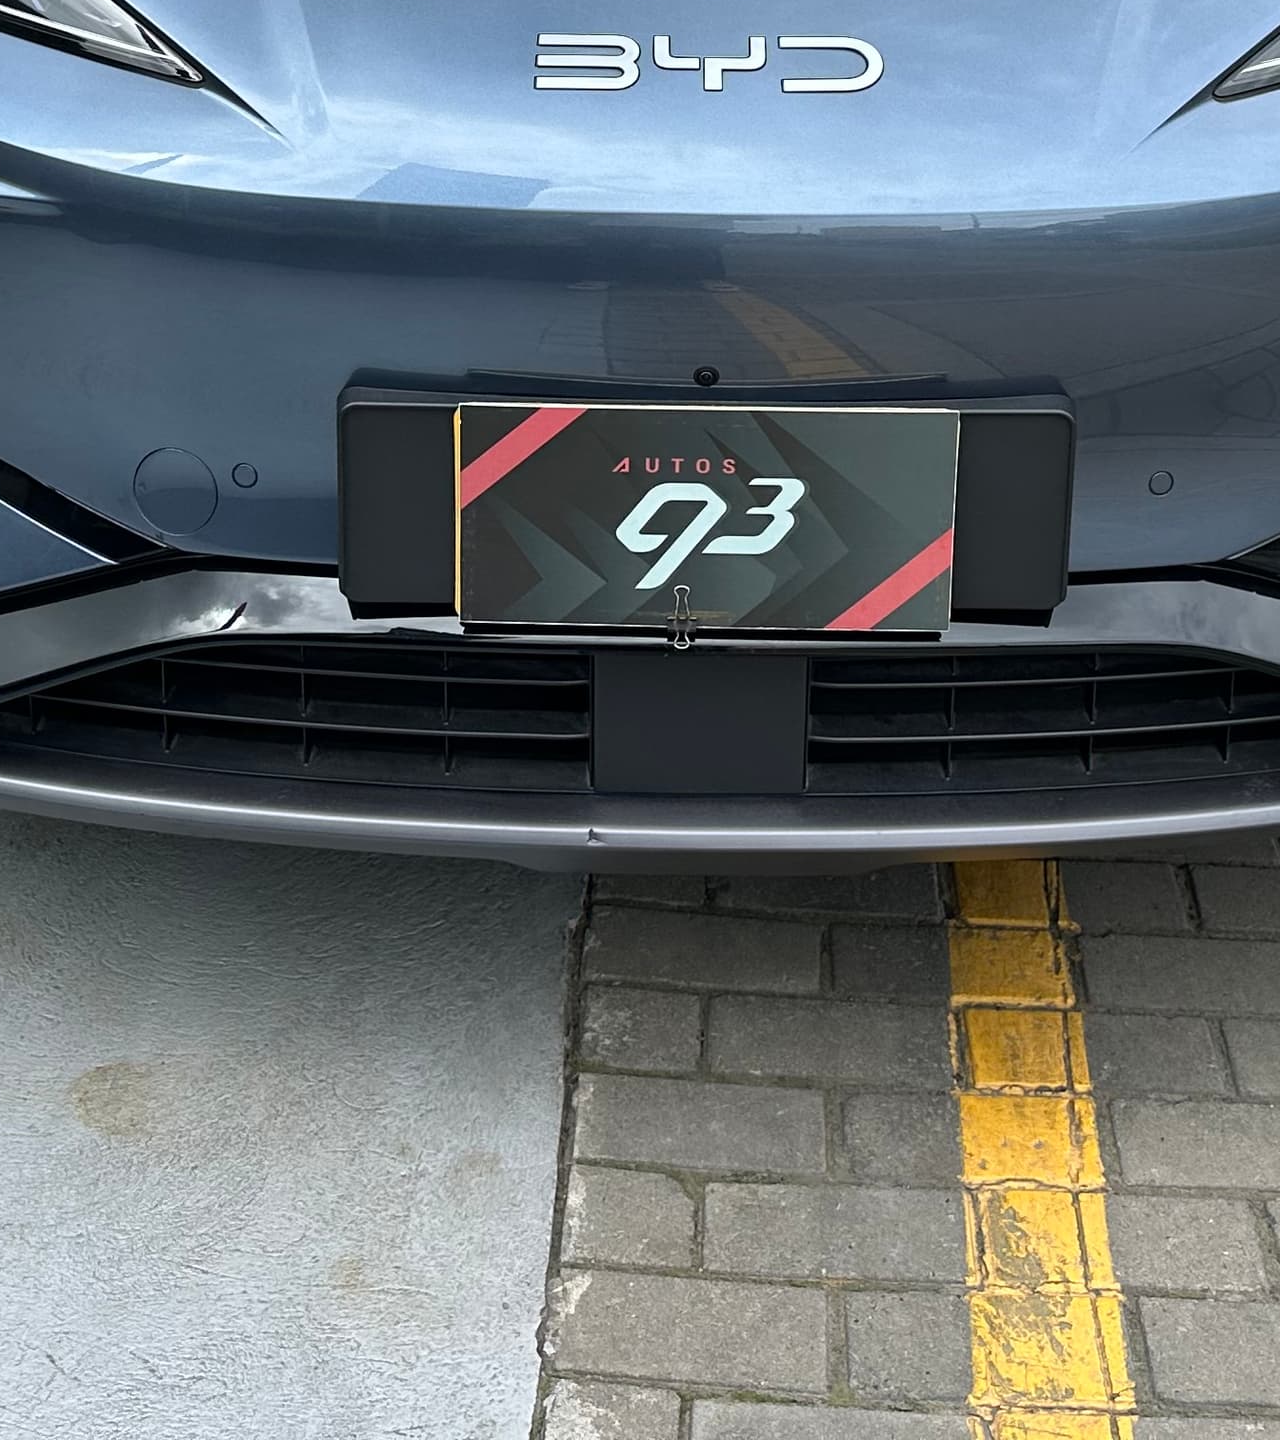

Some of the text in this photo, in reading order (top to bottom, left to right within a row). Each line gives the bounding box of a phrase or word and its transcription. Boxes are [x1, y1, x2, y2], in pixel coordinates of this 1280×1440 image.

[533, 32, 885, 94] BYD
[612, 457, 737, 475] AUTOS
[616, 477, 806, 590] 93
